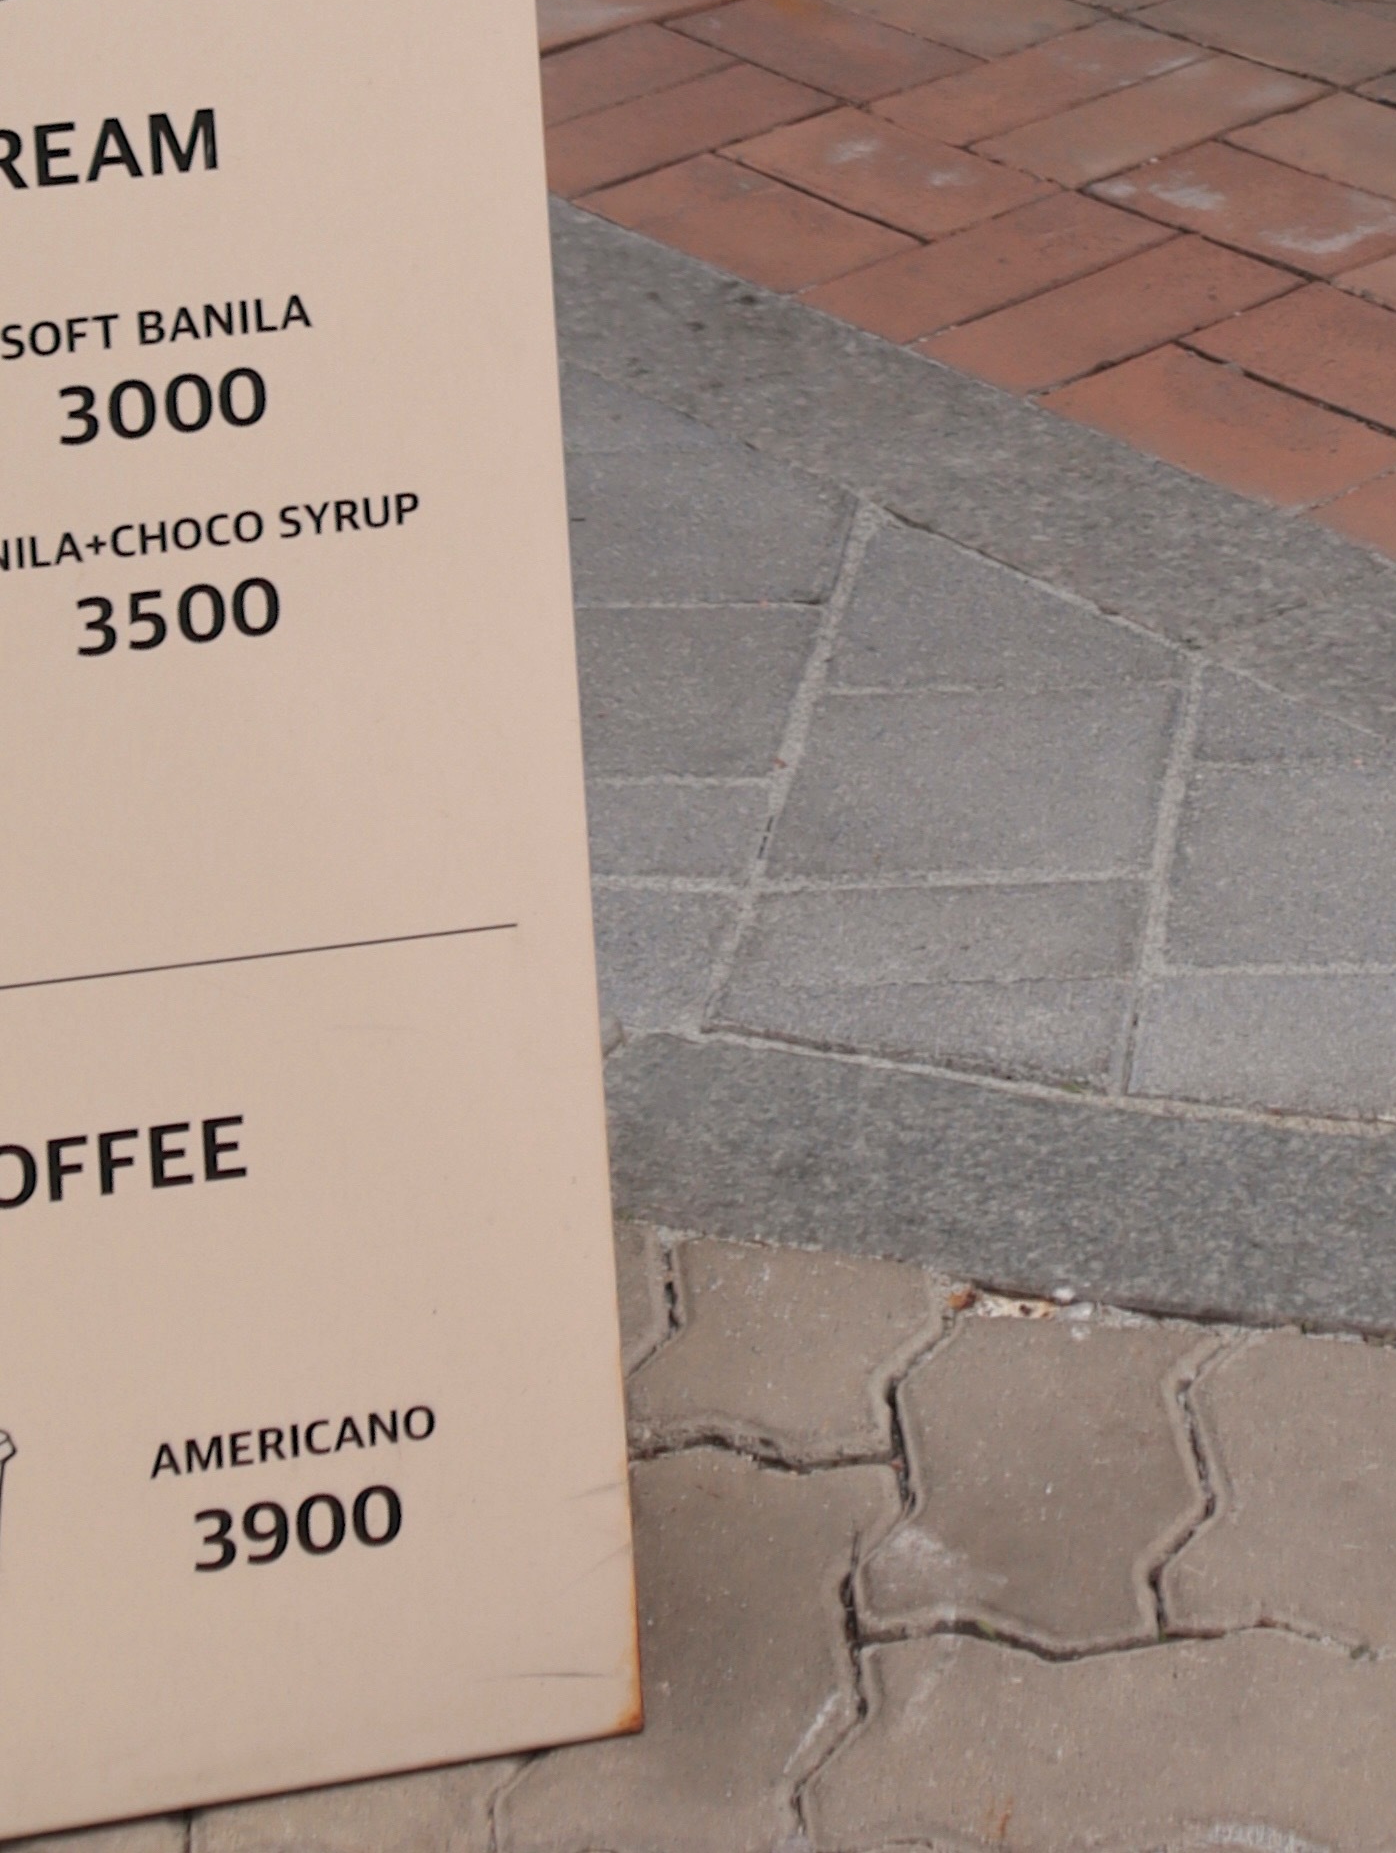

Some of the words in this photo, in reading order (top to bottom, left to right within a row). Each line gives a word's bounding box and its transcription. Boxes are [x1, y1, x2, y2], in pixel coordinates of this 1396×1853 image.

[1, 314, 119, 360] SOFT
[137, 295, 312, 345] BANILA
[58, 367, 267, 446] 3000
[279, 492, 420, 539] SYRUP
[77, 577, 280, 657] 3500
[150, 1405, 436, 1480] AMERICANO
[194, 1484, 403, 1573] 3900
